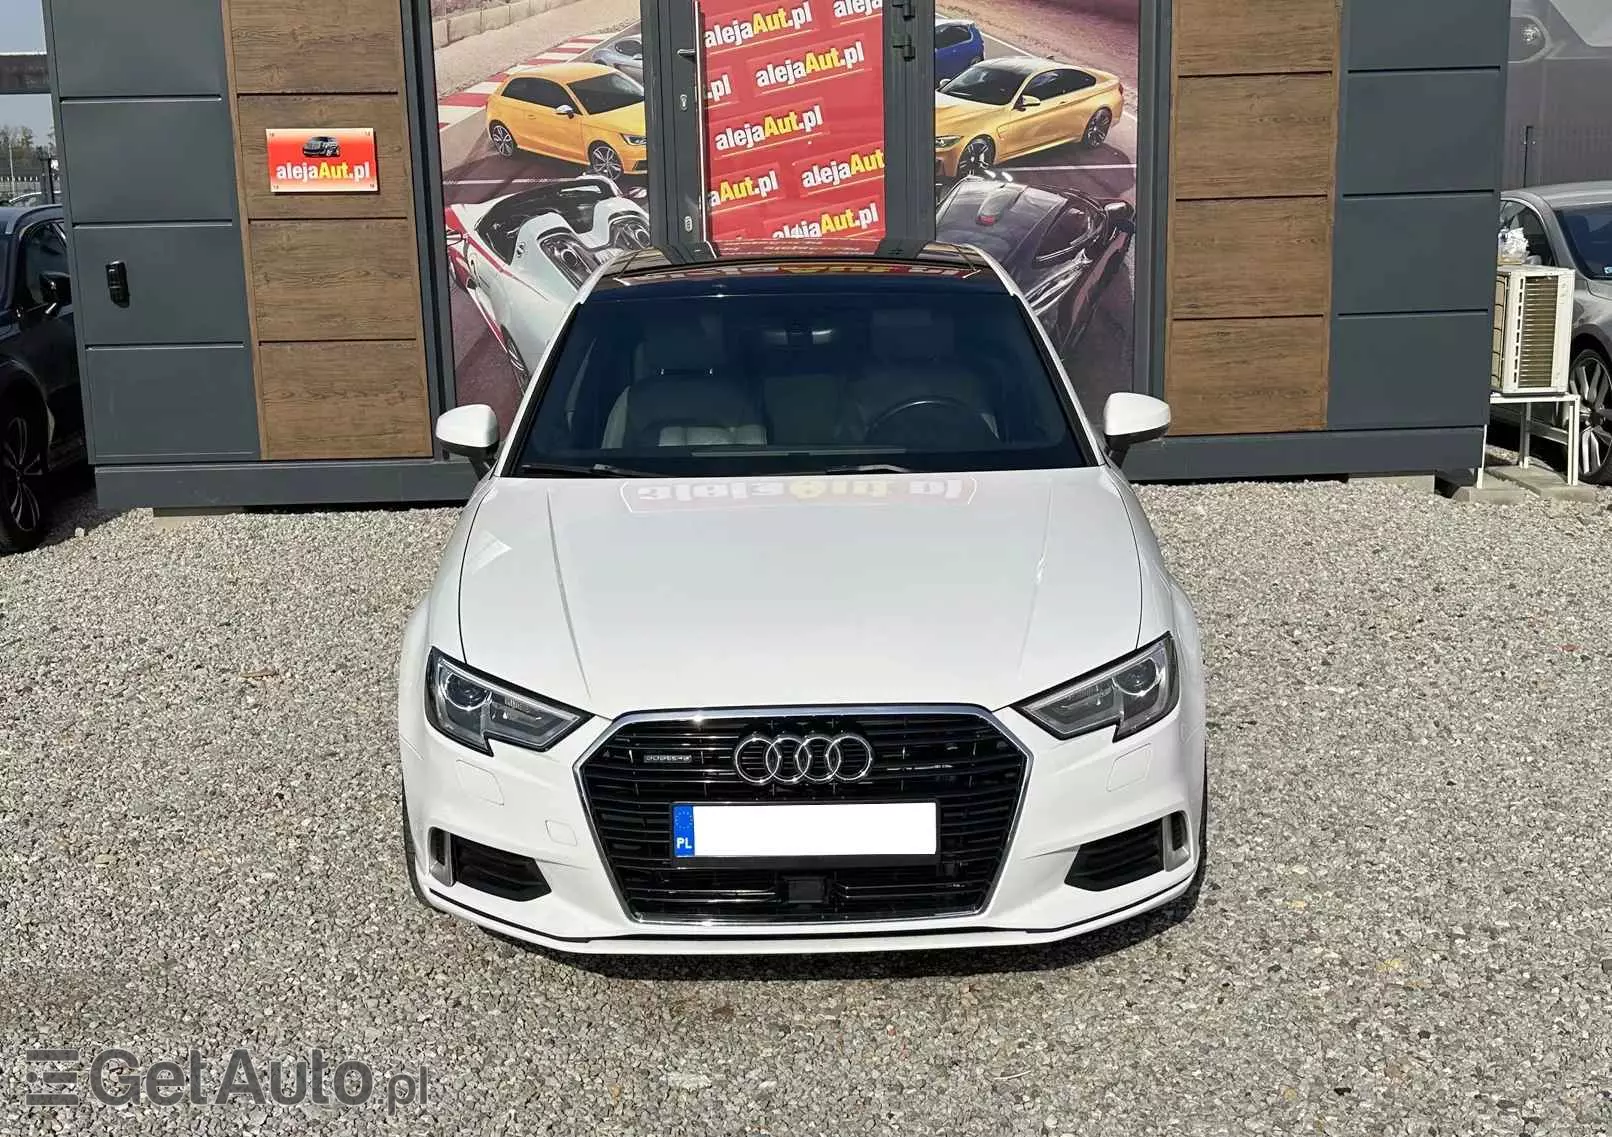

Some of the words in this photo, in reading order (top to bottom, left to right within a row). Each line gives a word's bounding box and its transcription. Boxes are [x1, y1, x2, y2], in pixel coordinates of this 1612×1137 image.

[704, 1, 813, 48] alejaAut.pl
[755, 41, 865, 87] alejaAut.pl
[714, 105, 823, 151] alejaAut.pl
[276, 161, 370, 182] alejaAut.pl
[676, 837, 693, 849] PL
